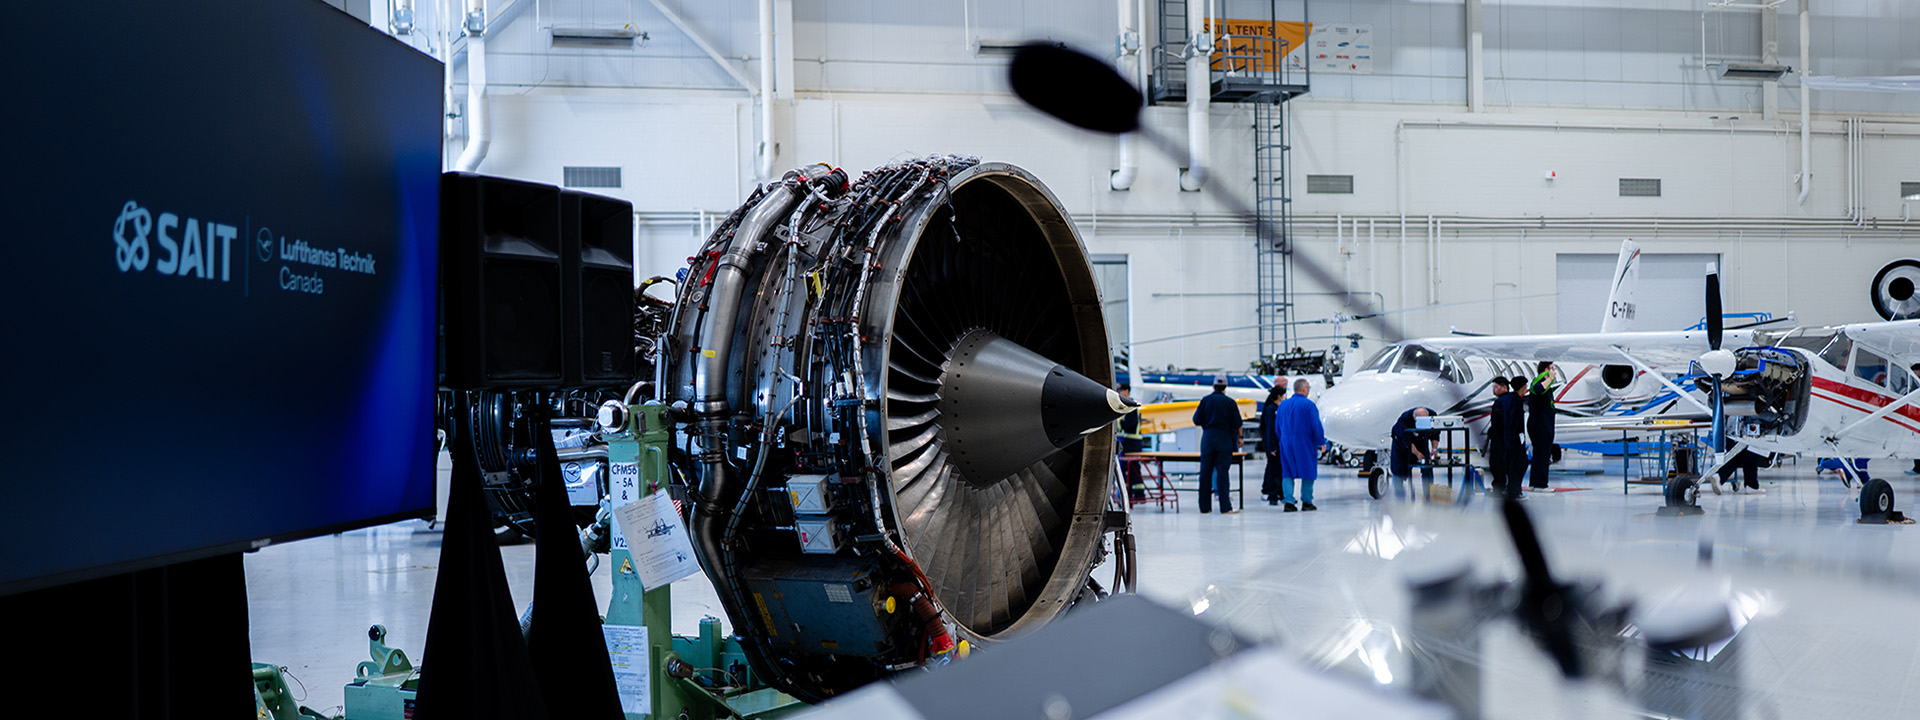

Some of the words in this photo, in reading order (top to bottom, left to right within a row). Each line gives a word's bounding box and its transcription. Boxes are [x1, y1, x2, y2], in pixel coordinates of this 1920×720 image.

[1235, 25, 1264, 35] TENT
[156, 213, 238, 282] SAIT
[280, 237, 336, 268] Lufthansa
[337, 248, 376, 275] Technik
[280, 266, 323, 294] Canada
[612, 465, 637, 475] CFM56
[623, 478, 633, 487] 5A
[622, 490, 628, 500] &
